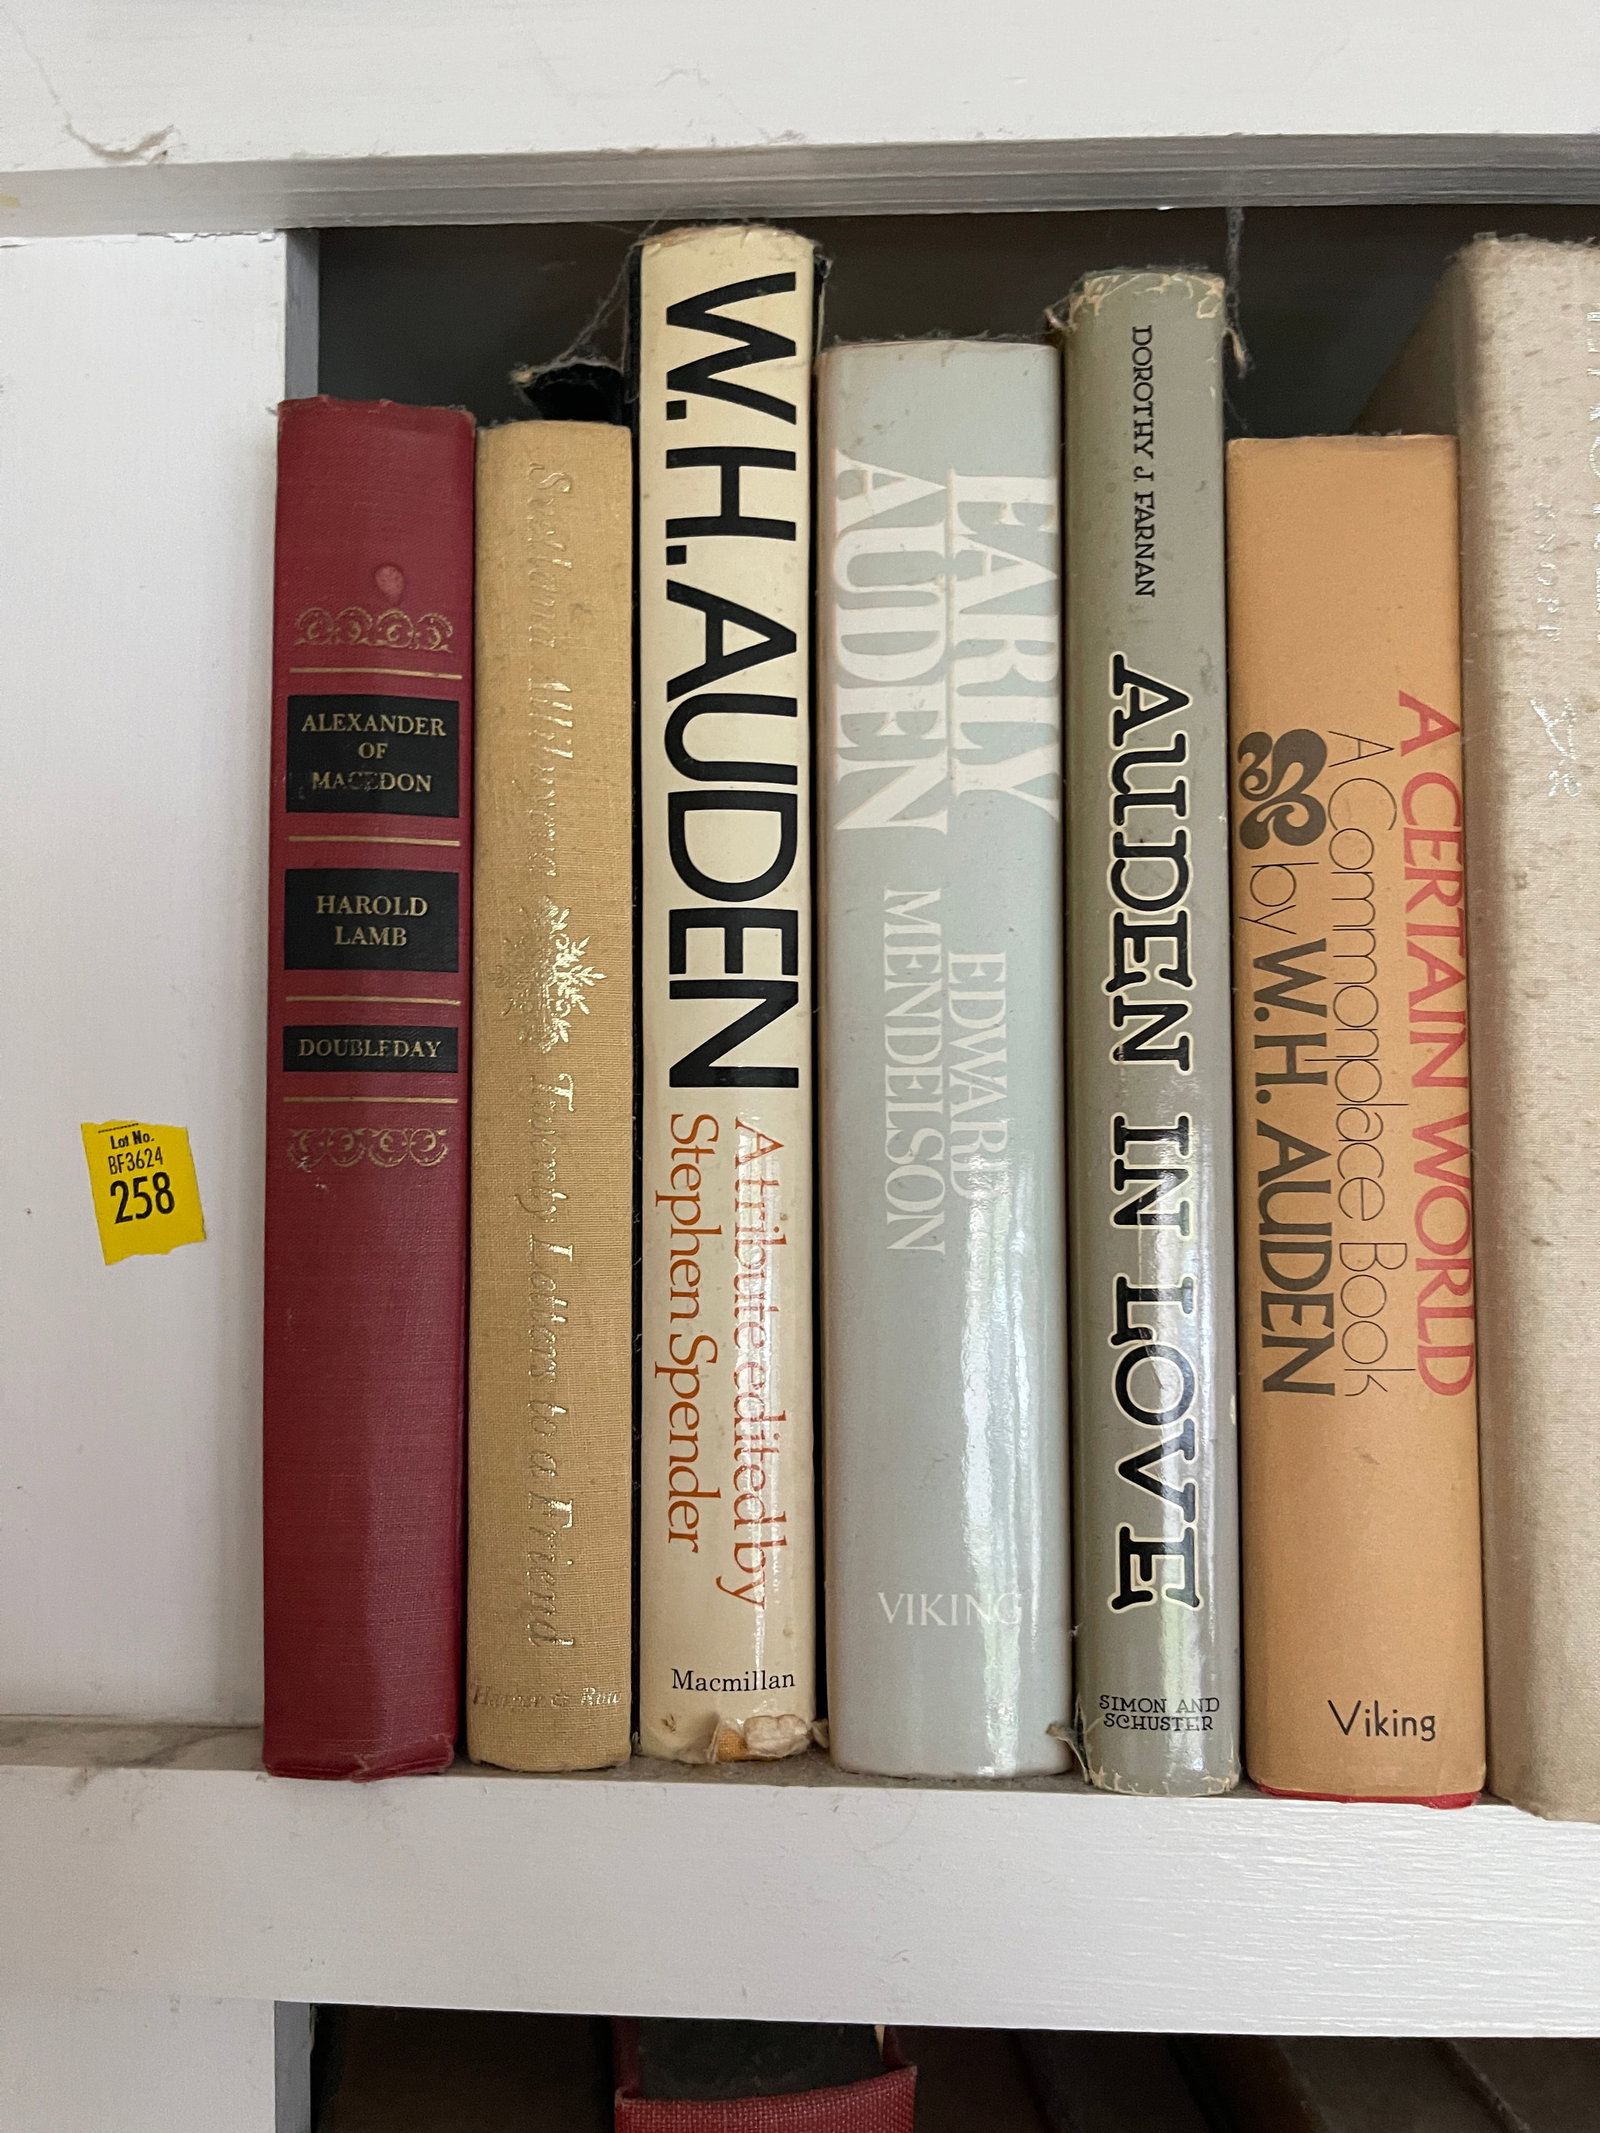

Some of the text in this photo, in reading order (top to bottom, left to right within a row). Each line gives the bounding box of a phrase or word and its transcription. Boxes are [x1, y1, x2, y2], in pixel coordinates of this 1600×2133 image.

[1132, 325, 1155, 598] DOROTHY J. FARNAN
[832, 447, 948, 836] AUDEN
[947, 466, 1059, 822] EARLY
[301, 713, 447, 736] ALEXANDER
[357, 742, 388, 759] OF
[315, 895, 428, 917] HAROLD
[1239, 862, 1319, 935] by
[335, 926, 407, 947] LAMB
[297, 1038, 442, 1058] DOUBLEDAY
[884, 887, 945, 1256] MENDELSON
[1304, 731, 1416, 1396] A Commonplace Book
[1398, 690, 1475, 1397] A CERTAIN WORLD
[948, 951, 1009, 1201] EDWARD
[107, 1146, 163, 1175] BF3624
[110, 1130, 154, 1150] Lot No.
[1102, 651, 1204, 1615] AUDEN IN LOVE
[110, 1171, 175, 1224] 258
[1257, 1119, 1335, 1396] AUDEN
[513, 1073, 574, 1647] Twenty Letters to a Friend
[654, 1113, 722, 1553] Stephen Spender
[715, 1117, 787, 1610] A tribute edited by
[878, 1592, 1022, 1626] VIKING
[671, 1668, 796, 1692] Macmillan
[1099, 1694, 1220, 1714] SIMON AND
[1103, 1712, 1214, 1732] SCHUSTER
[1328, 1700, 1436, 1742] Viking
